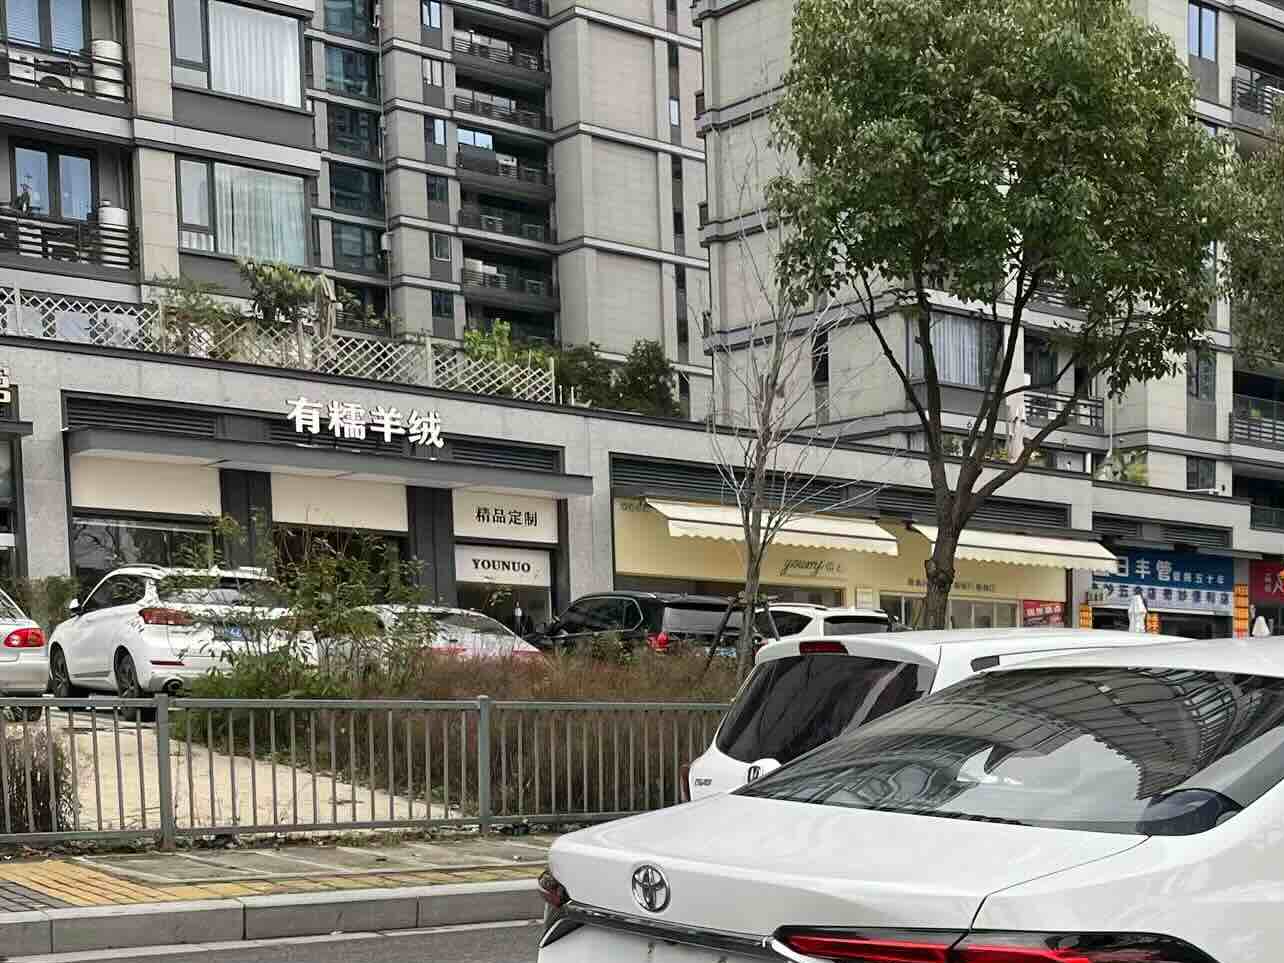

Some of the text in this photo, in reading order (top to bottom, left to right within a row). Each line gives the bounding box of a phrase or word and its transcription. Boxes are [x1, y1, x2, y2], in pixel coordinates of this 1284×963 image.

[286, 397, 445, 449] 有糯羊绒
[475, 507, 538, 527] 精品定制
[471, 558, 531, 573] YOUNUO
